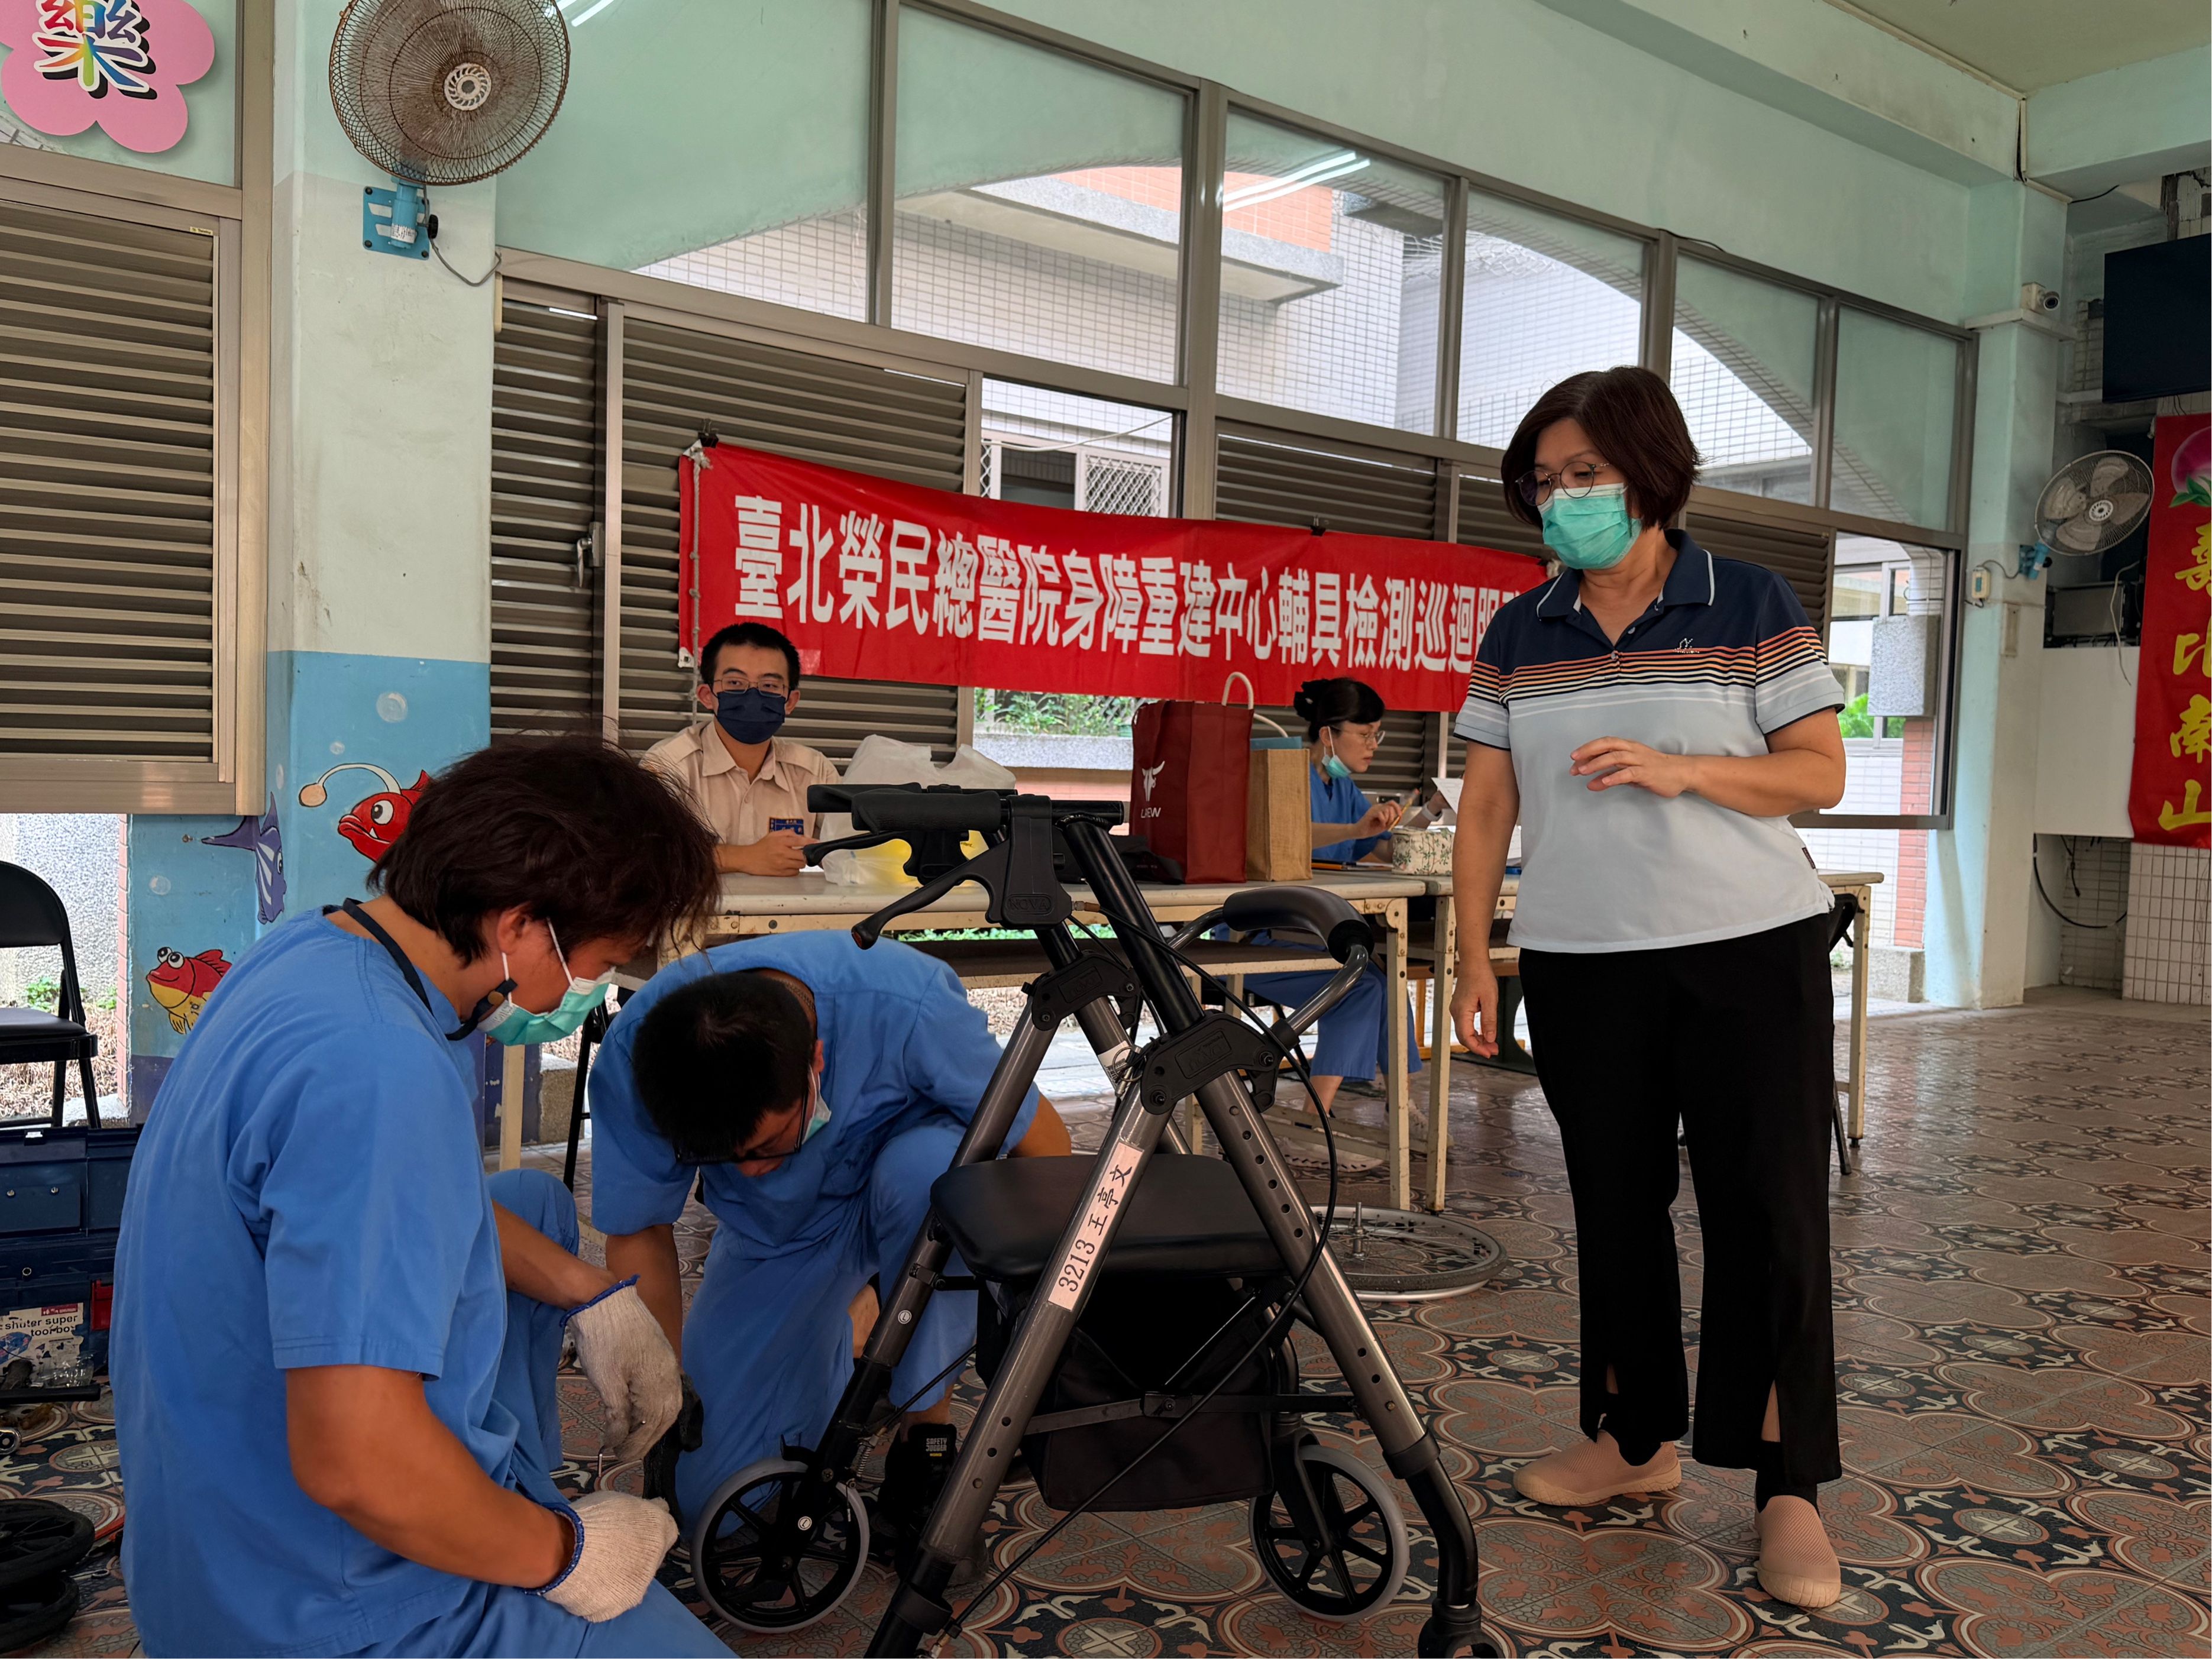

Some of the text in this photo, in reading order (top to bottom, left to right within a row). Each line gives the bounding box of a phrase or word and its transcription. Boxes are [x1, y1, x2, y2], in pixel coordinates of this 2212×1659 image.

[34, 0, 149, 92] 樂
[1008, 898, 1050, 911] NOVA
[1059, 1239, 1095, 1292] 3213
[46, 1315, 78, 1325] super
